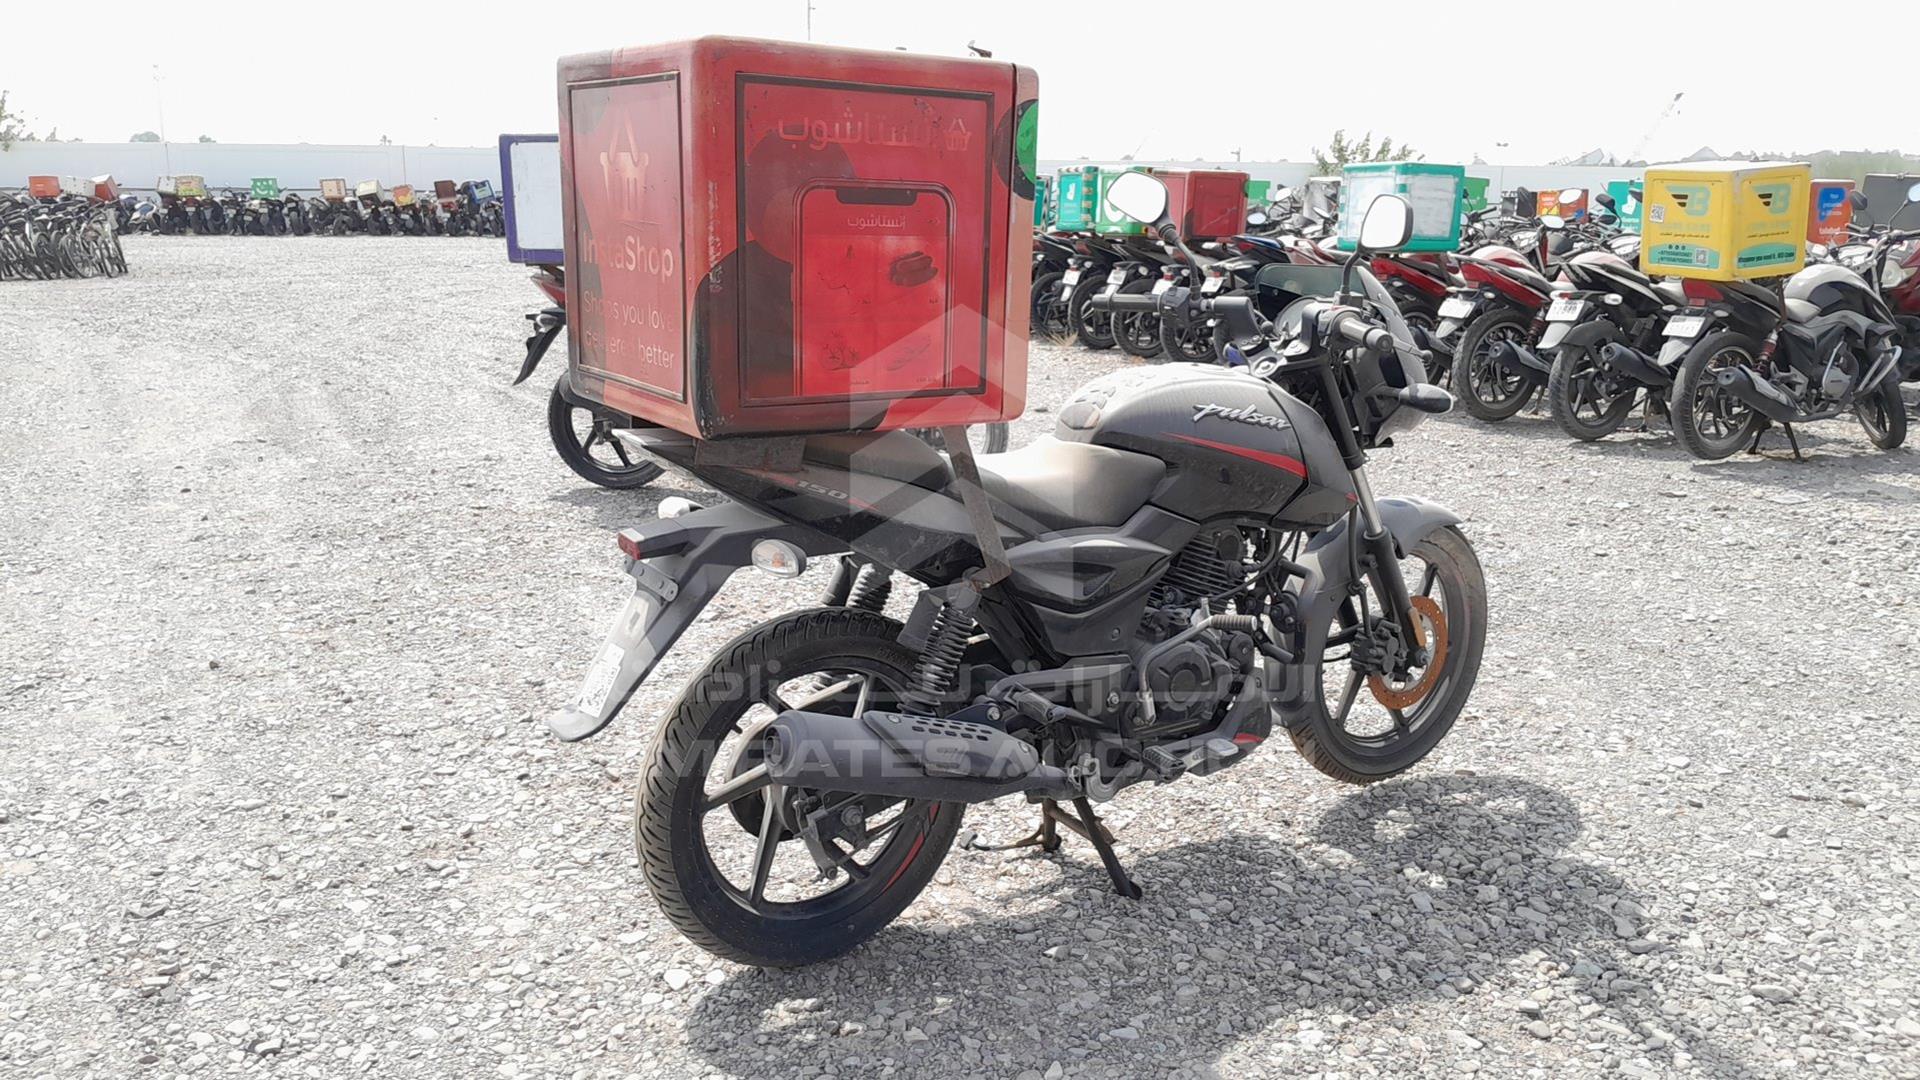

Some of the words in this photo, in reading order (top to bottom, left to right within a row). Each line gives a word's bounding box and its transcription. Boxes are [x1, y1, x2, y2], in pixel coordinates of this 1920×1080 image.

[583, 232, 674, 283] InaShop
[583, 290, 619, 321] Shs
[623, 303, 644, 325] you
[638, 337, 674, 369] better
[798, 480, 849, 500] 150
